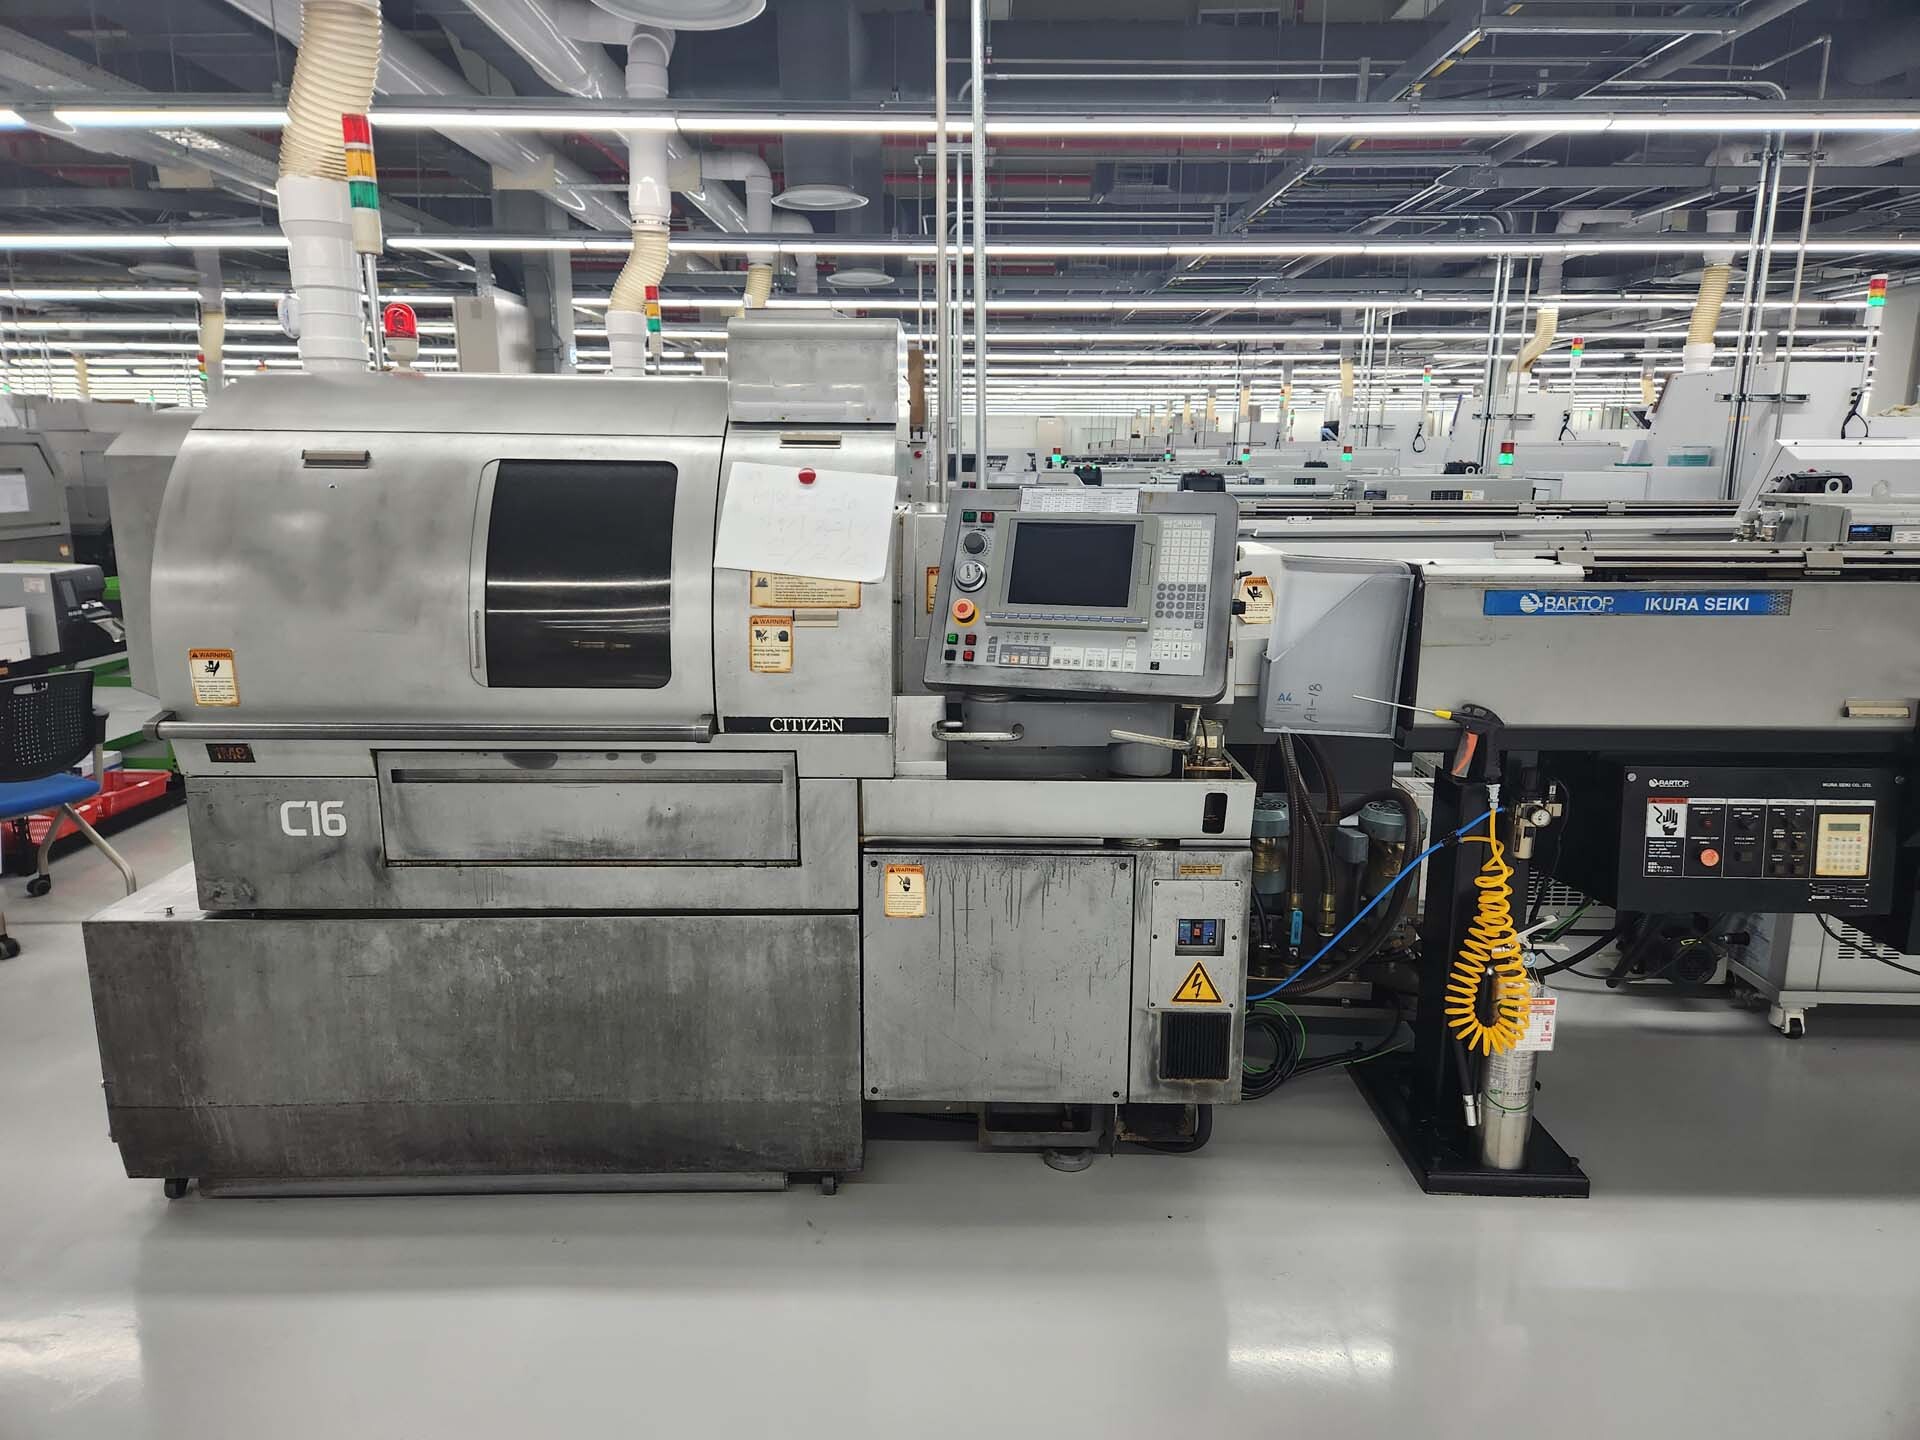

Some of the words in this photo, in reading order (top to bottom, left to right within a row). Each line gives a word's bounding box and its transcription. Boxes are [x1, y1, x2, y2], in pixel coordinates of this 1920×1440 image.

[1544, 596, 1615, 612] BARTOP
[1644, 597, 1699, 611] IKURA
[1703, 598, 1750, 611] SEIKI
[769, 717, 844, 732] CITIZEN
[280, 800, 347, 836] C16
